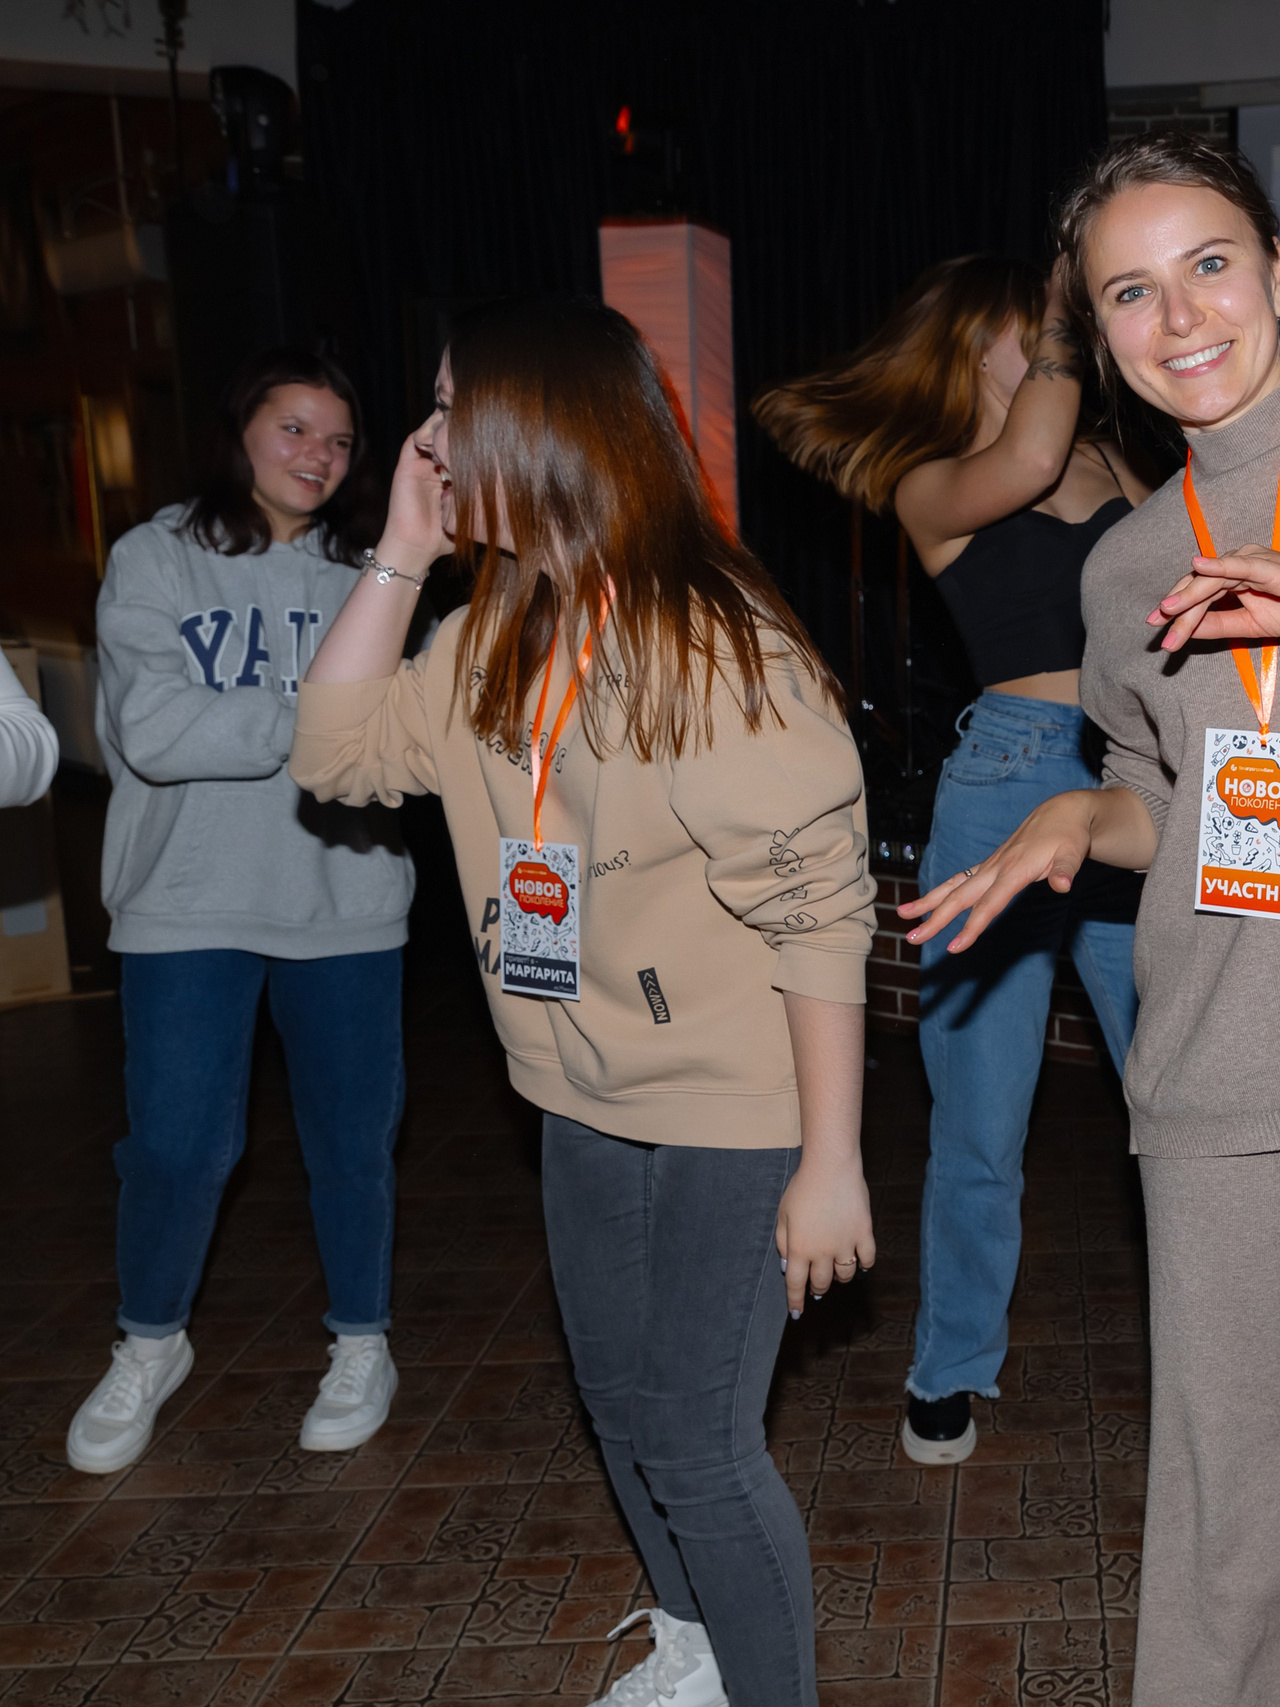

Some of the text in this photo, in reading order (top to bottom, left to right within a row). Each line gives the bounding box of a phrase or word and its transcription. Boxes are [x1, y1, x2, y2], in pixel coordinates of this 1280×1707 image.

[514, 878, 563, 899] НОВОЕ
[519, 894, 564, 908] ПОКОЛЕНИЕ
[505, 962, 576, 985] МАРГАРИТА
